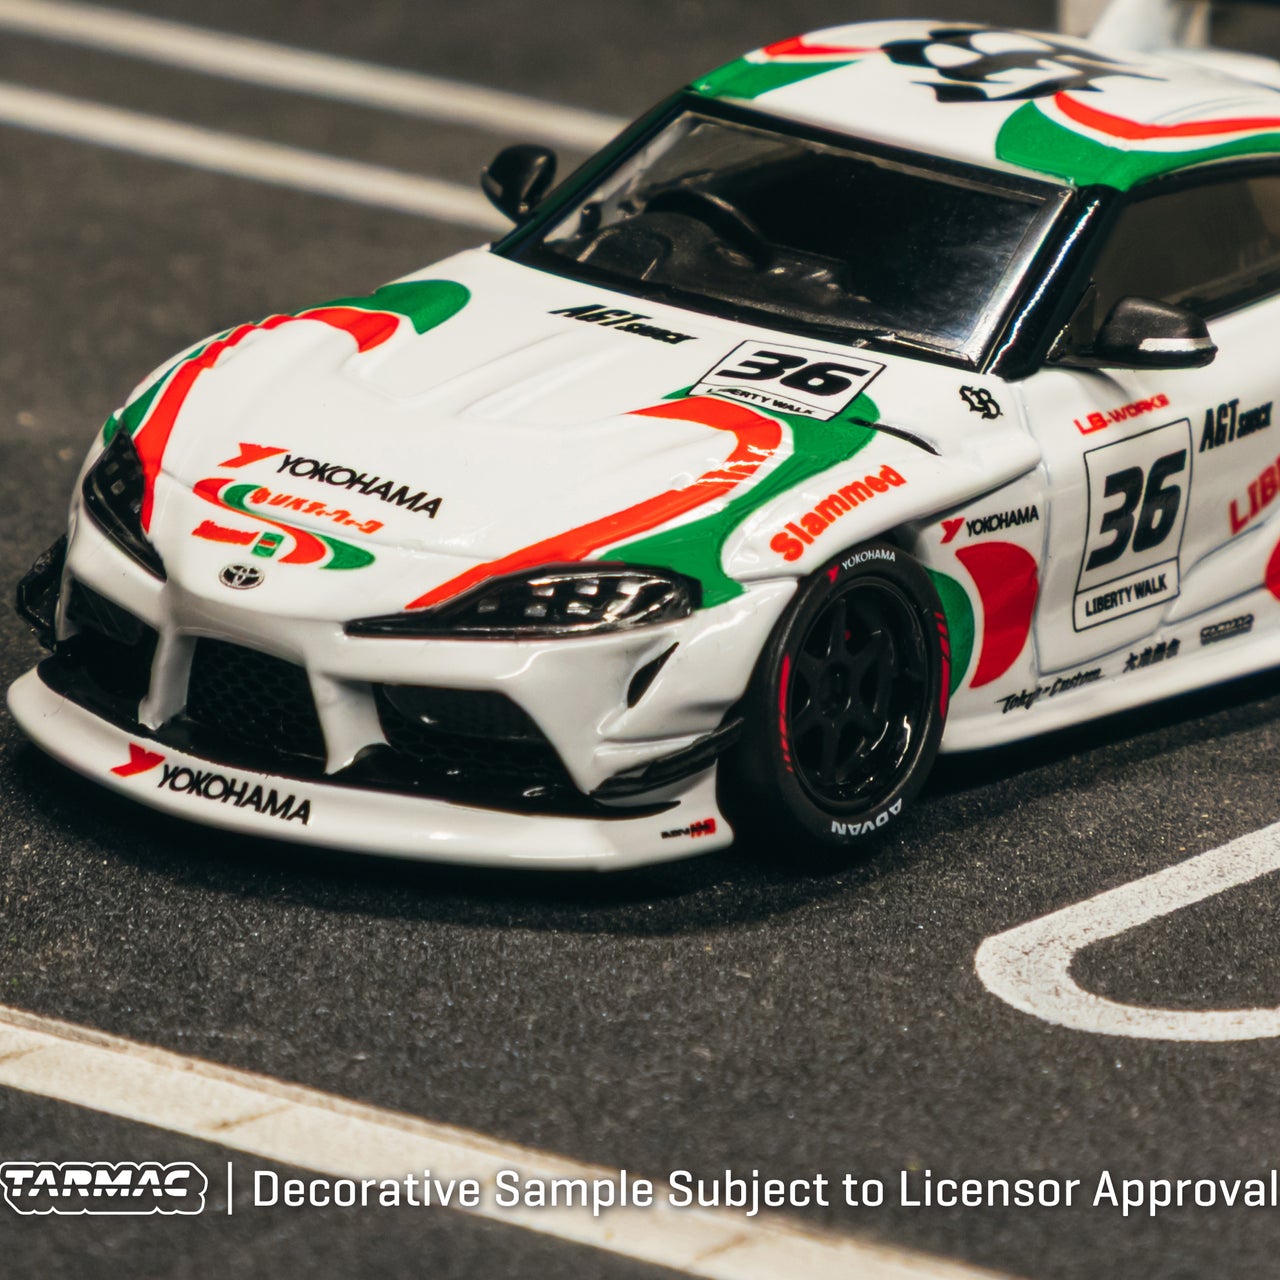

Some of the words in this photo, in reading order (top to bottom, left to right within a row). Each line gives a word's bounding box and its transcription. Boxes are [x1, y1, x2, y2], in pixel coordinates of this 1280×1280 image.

[706, 387, 771, 404] LERTY
[714, 350, 871, 396] 36
[276, 454, 443, 519] YOKOHAMA
[769, 464, 907, 562] Slammed
[966, 504, 1039, 537] YOKOHAMA
[1085, 449, 1187, 572] 36
[841, 548, 896, 570] YOKOHAMA
[1085, 586, 1133, 617] LIBERTY
[1132, 573, 1168, 600] WALK
[157, 764, 310, 825] YOKOHAMA
[831, 798, 903, 835] ADVAN
